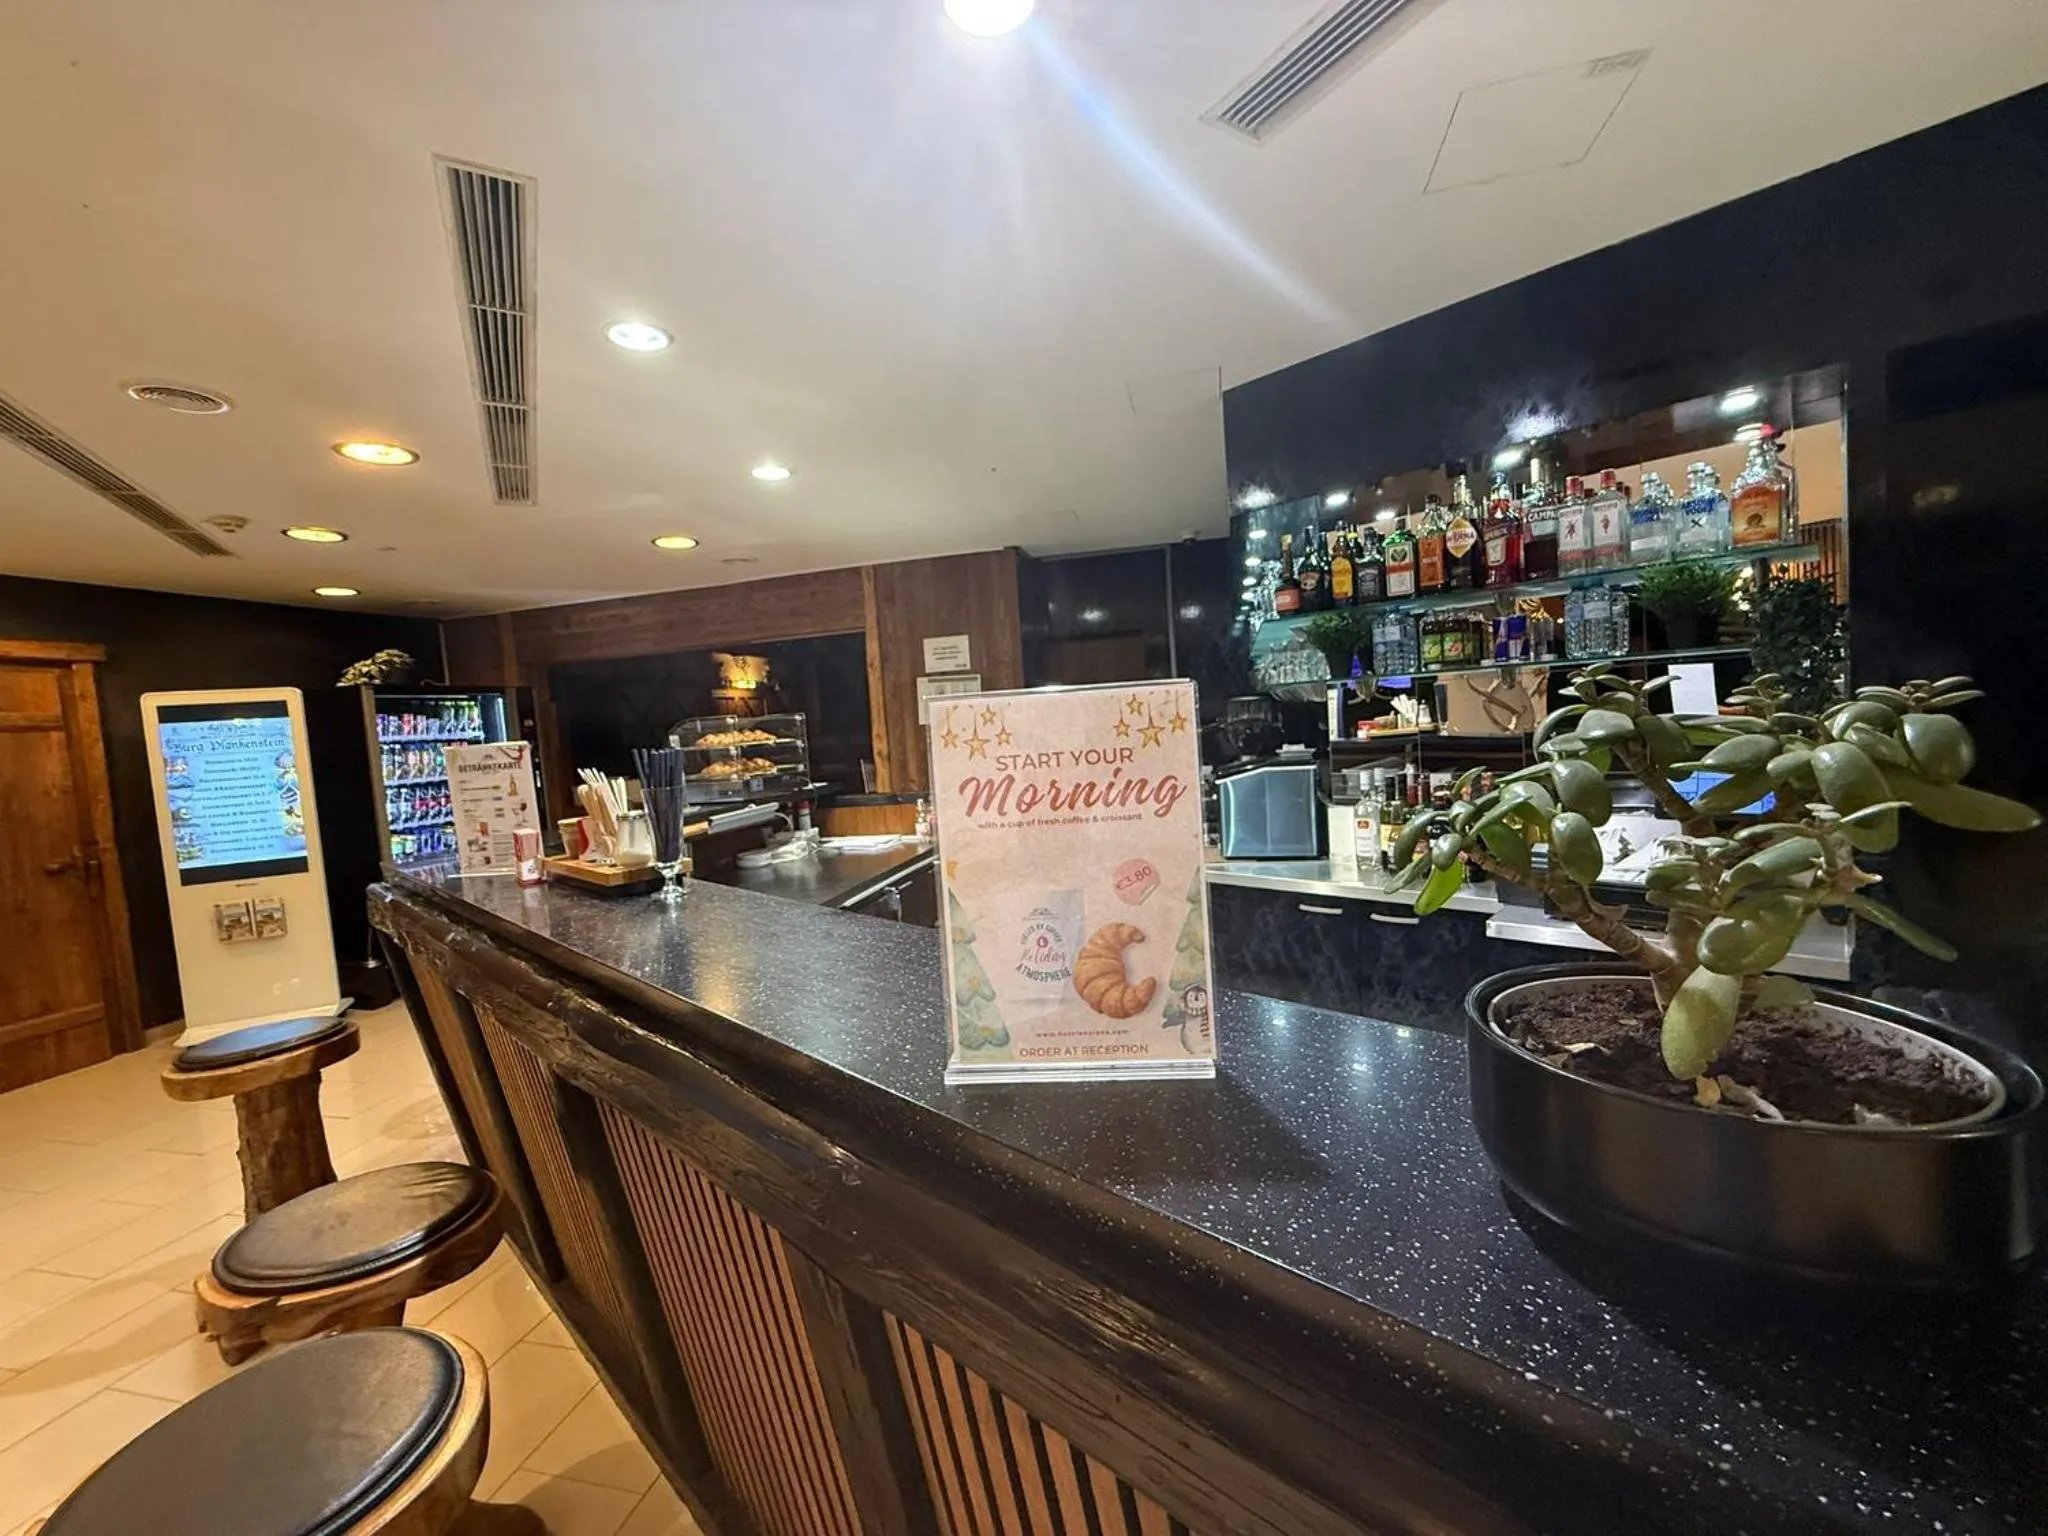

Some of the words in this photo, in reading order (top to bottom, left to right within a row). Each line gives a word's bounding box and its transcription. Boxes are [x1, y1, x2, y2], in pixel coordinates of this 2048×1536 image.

[996, 752, 1064, 772] START
[1070, 748, 1133, 766] YOUR
[959, 767, 1188, 818] Morning
[977, 821, 999, 830] with
[1006, 820, 1025, 829] cup
[1026, 819, 1035, 827] of
[1037, 818, 1061, 826] fresh
[1062, 815, 1090, 825] coffee
[1101, 813, 1143, 822] croissant
[1115, 865, 1152, 890] €3.80
[1015, 963, 1072, 983] ATMOSPHERE
[1019, 1047, 1061, 1058] ORDER
[1064, 1046, 1079, 1056] AT
[1081, 1044, 1149, 1056] RECEPTION
